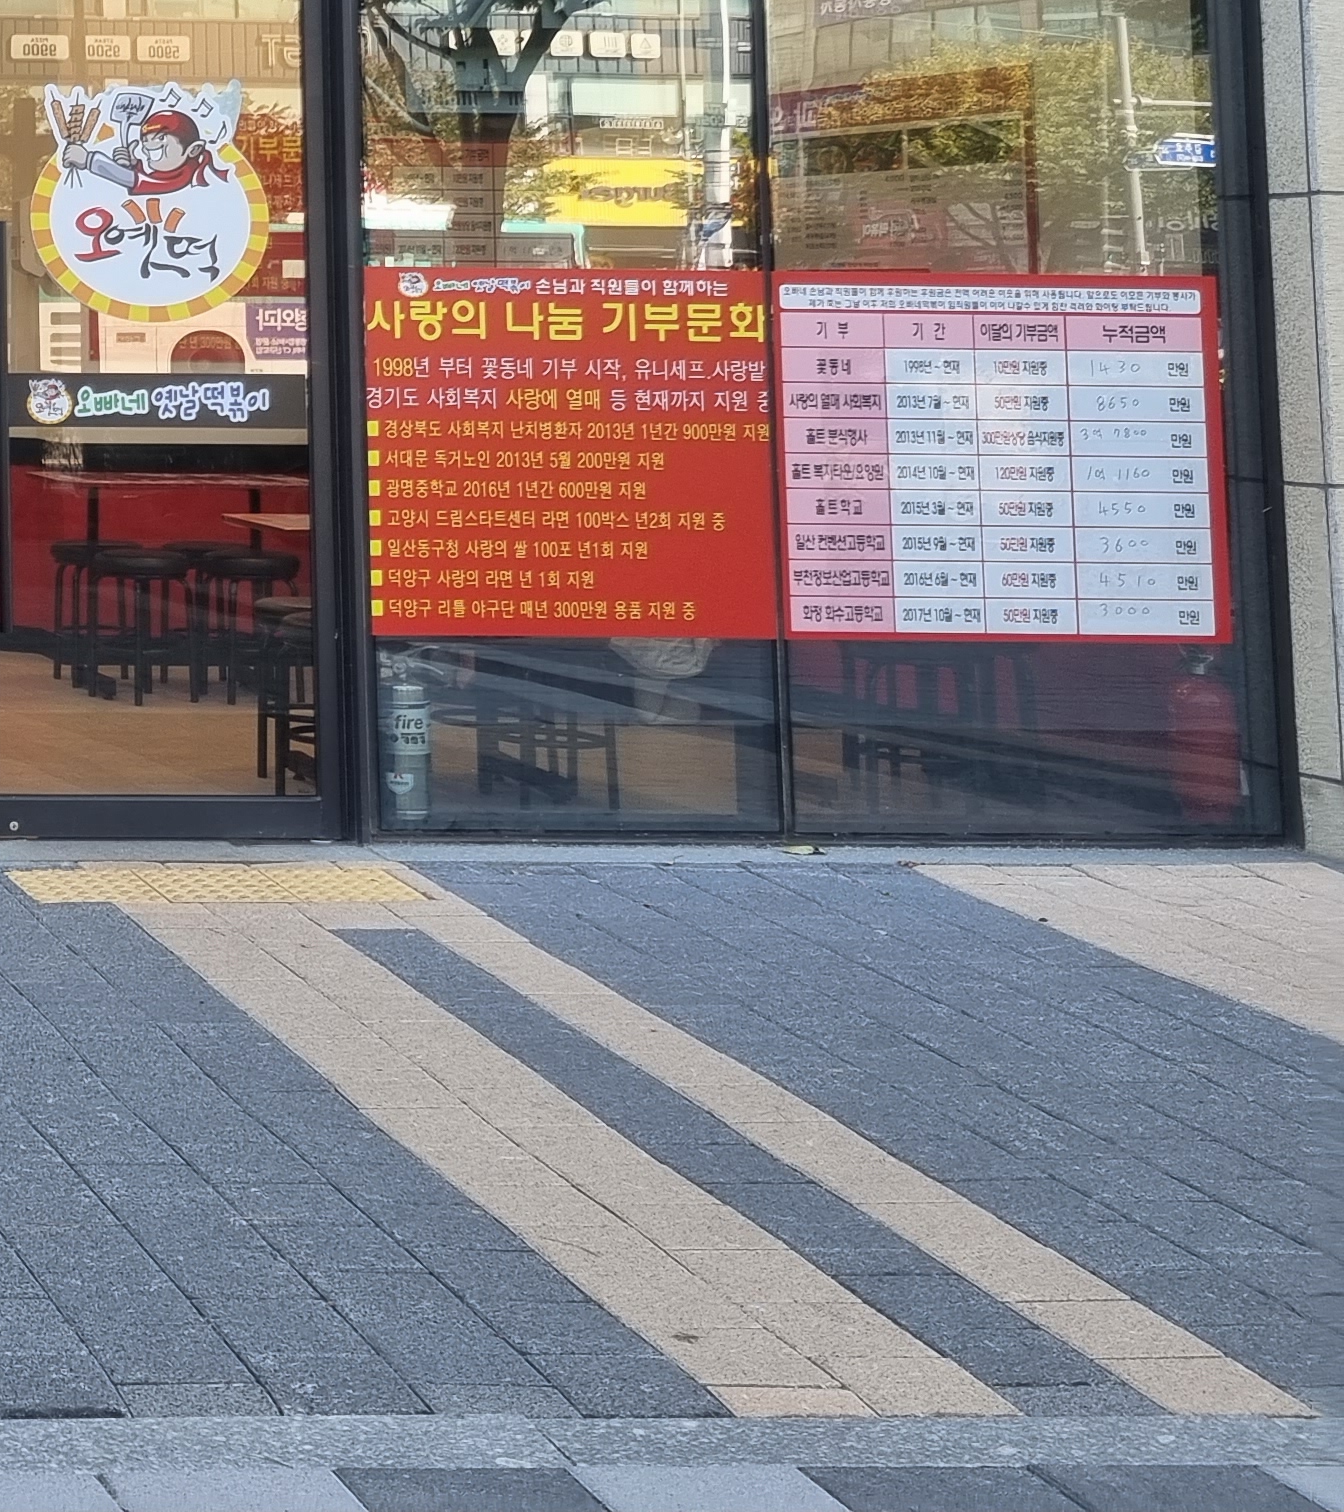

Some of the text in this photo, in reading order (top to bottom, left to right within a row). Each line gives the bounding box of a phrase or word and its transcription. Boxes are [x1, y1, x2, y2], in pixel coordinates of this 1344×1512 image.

[535, 278, 728, 296] 손님과 직원들이 함께하는
[367, 300, 764, 342] 사랑의 나눔 기부문화
[980, 322, 1059, 342] 이달의 기부금액
[1103, 325, 1166, 344] 누적금액
[373, 357, 429, 378] 1998년
[439, 357, 472, 378] 부터
[481, 358, 533, 379] 꽃동네
[542, 358, 577, 380] 기부
[585, 359, 626, 381] 시작,
[1090, 360, 1140, 376] 1430
[77, 388, 147, 415] 오빠네
[367, 387, 419, 408] 경기도
[427, 388, 496, 409] 사회복지
[506, 388, 557, 410] 사랑에
[566, 389, 600, 410] 열매
[610, 389, 627, 411] 등
[635, 390, 705, 412] 현재까지
[714, 390, 748, 412] 지원
[790, 393, 818, 409] 사랑의
[843, 394, 881, 410] 사회복지
[1097, 396, 1140, 411] 8650
[1169, 398, 1191, 412] 만원
[385, 421, 769, 441] 경상북도 사회복지 난치병환자 2013년 1년간 900만원 지원
[1170, 434, 1192, 448] 만원
[385, 450, 665, 470] 서대문 독거노인 2013년 5월 200만원 지원
[386, 480, 646, 500] 광명중학교 2016년 1년간 600만원 지원
[1099, 502, 1146, 516] 4550
[387, 510, 725, 531] 고양시 드림스타트센터 라면 100박스 년2회 지원 중
[388, 539, 648, 560] 일산동구청 사랑의 쌀 100포 년1회 지원
[1100, 537, 1149, 553] 3600
[388, 569, 594, 589] 덕양구 사랑의 라면 년 1회 지원
[1100, 572, 1155, 587] 4510
[389, 599, 696, 620] 덕양구 리틀 야구단 매년 300만원 용품 지원 중
[803, 606, 822, 621] 화정
[1100, 604, 1150, 616] 3000
[1179, 611, 1200, 625] 만원
